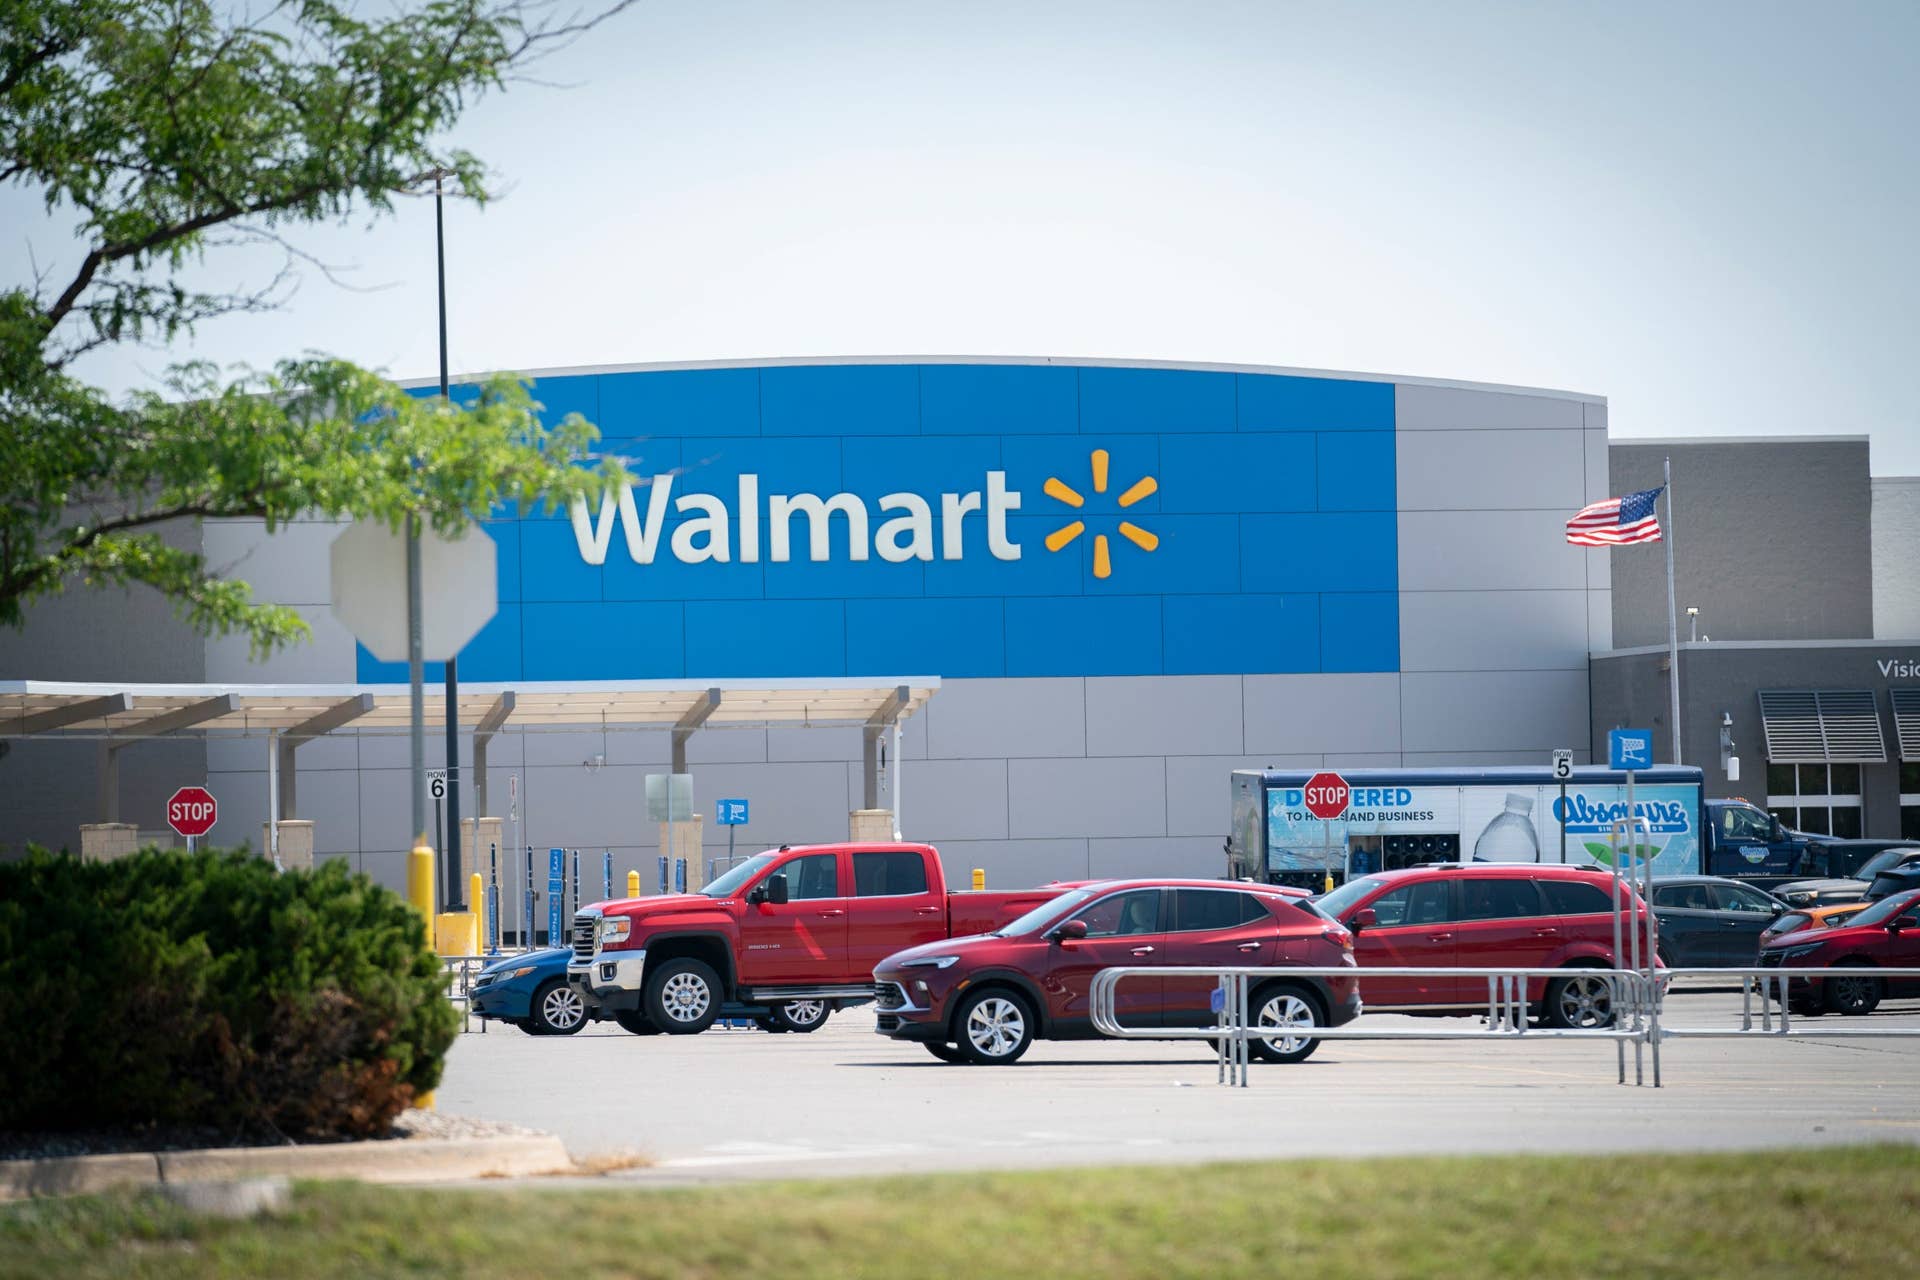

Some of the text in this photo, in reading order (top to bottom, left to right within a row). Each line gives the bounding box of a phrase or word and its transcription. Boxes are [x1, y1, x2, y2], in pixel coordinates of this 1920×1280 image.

[569, 471, 1022, 565] Walmart
[1553, 751, 1573, 759] ROW
[427, 771, 446, 779] ROW
[1557, 758, 1570, 777] 5
[431, 778, 445, 798] 6
[1307, 787, 1347, 805] STOP
[1286, 788, 1412, 808] DERED
[171, 802, 214, 821] STOP
[1287, 812, 1303, 822] TO
[1351, 812, 1375, 822] AND
[1378, 811, 1434, 821] BUSINESS
